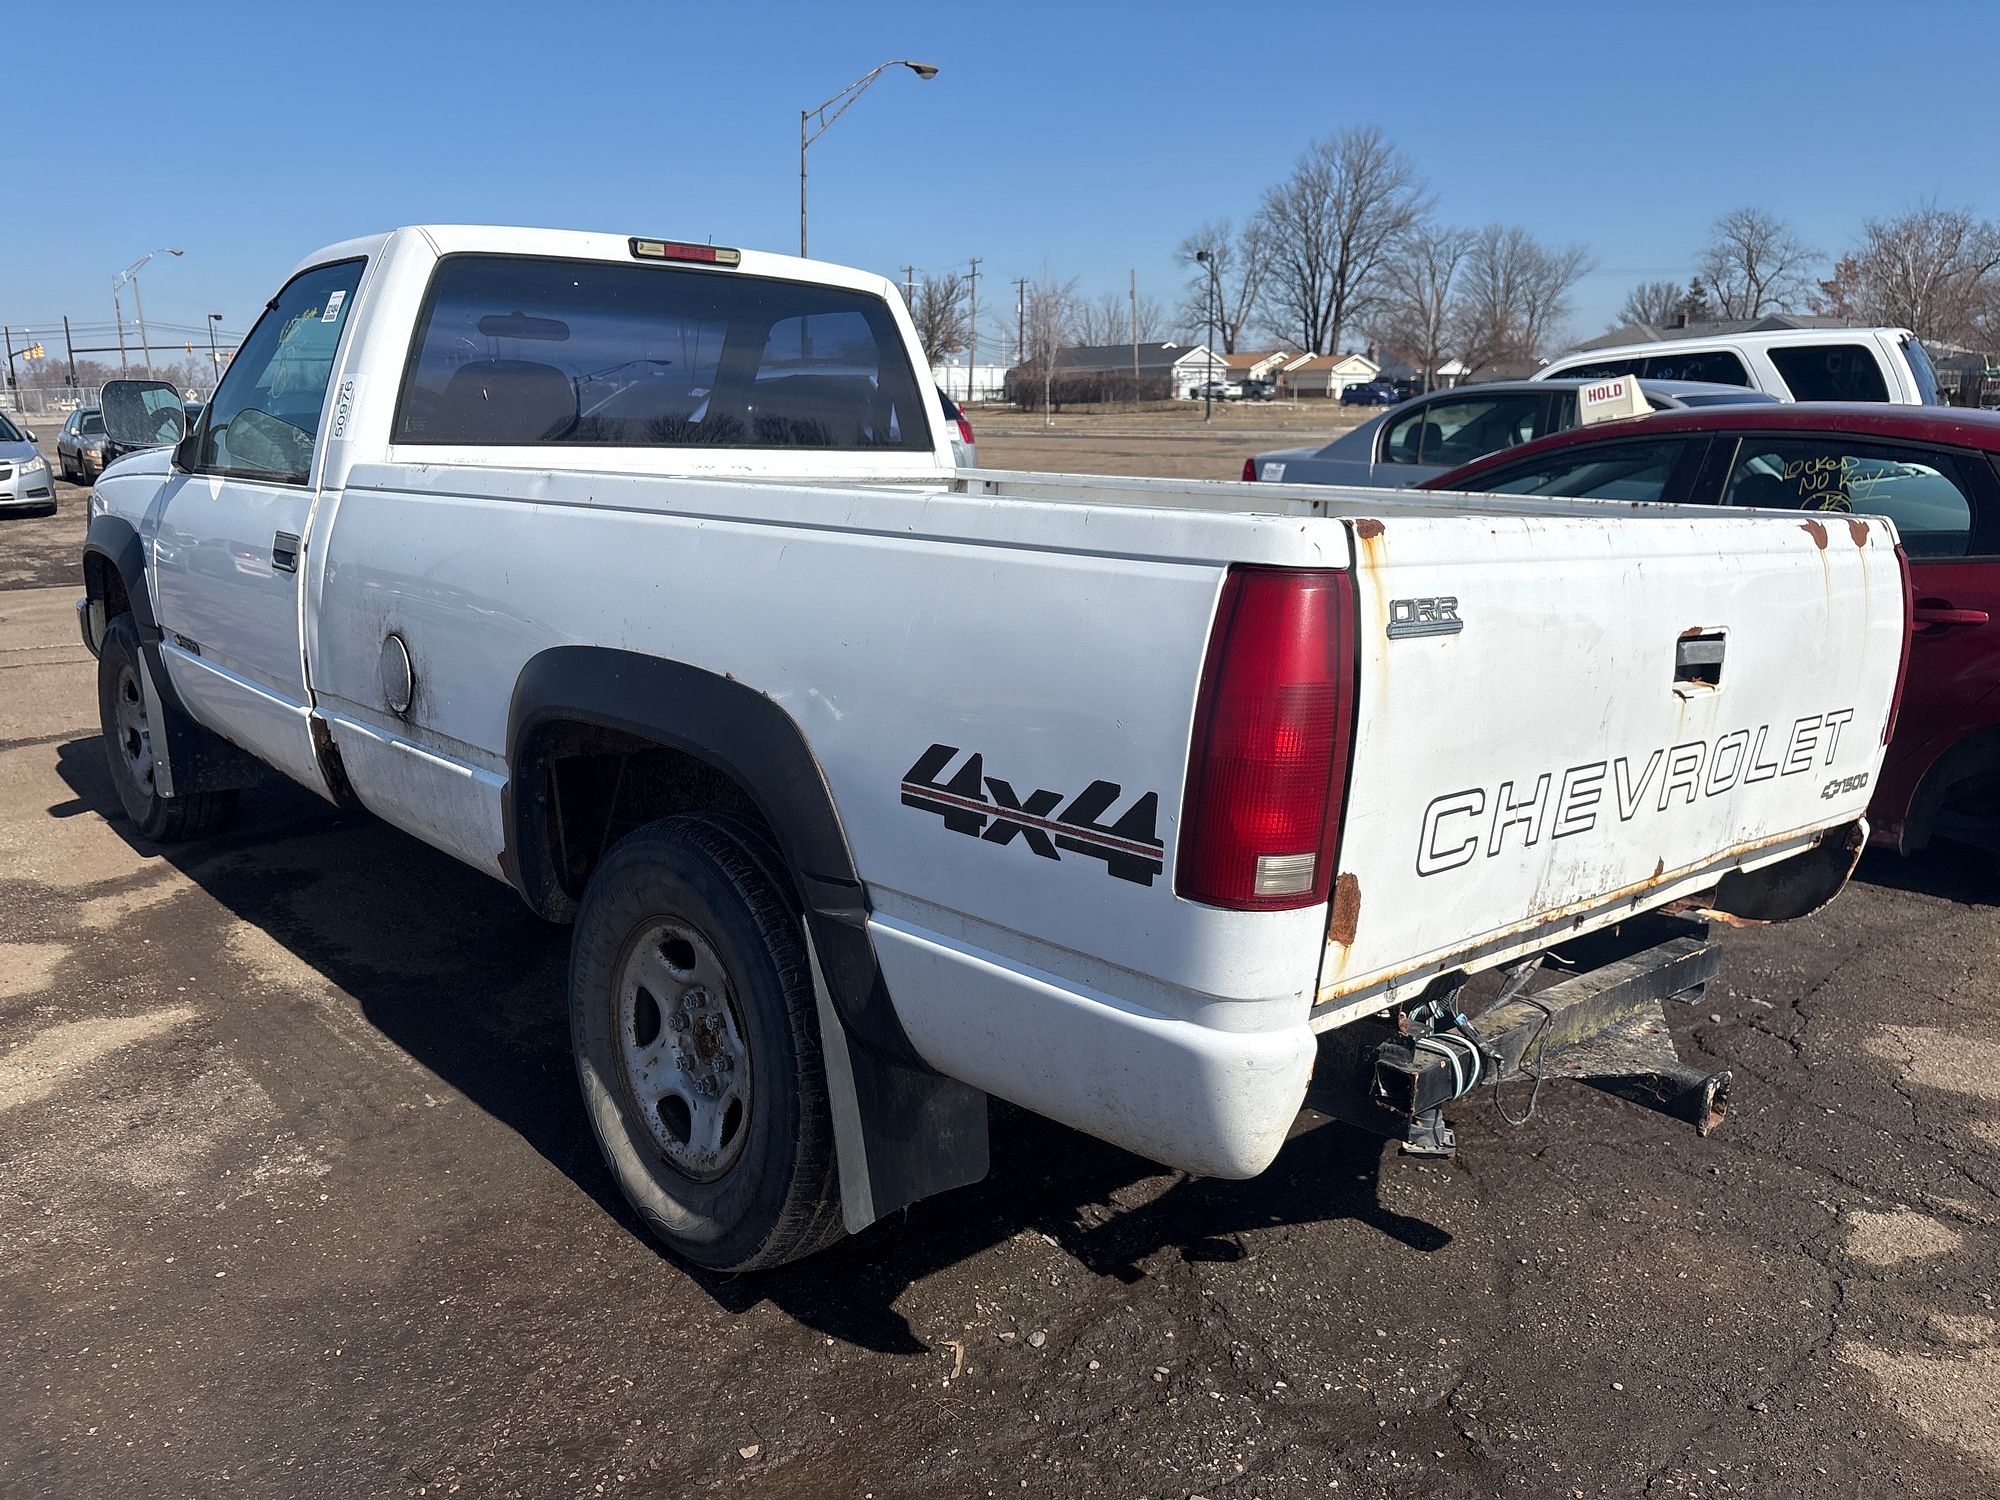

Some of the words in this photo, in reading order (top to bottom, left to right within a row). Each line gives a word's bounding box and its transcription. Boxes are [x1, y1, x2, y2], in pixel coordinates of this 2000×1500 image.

[1588, 384, 1622, 402] HOLD
[335, 381, 353, 437] 50976
[1799, 471, 1829, 495] NO
[1389, 597, 1460, 624] ORR
[1416, 708, 1854, 877] CHEVROLET
[1842, 772, 1869, 793] 1500
